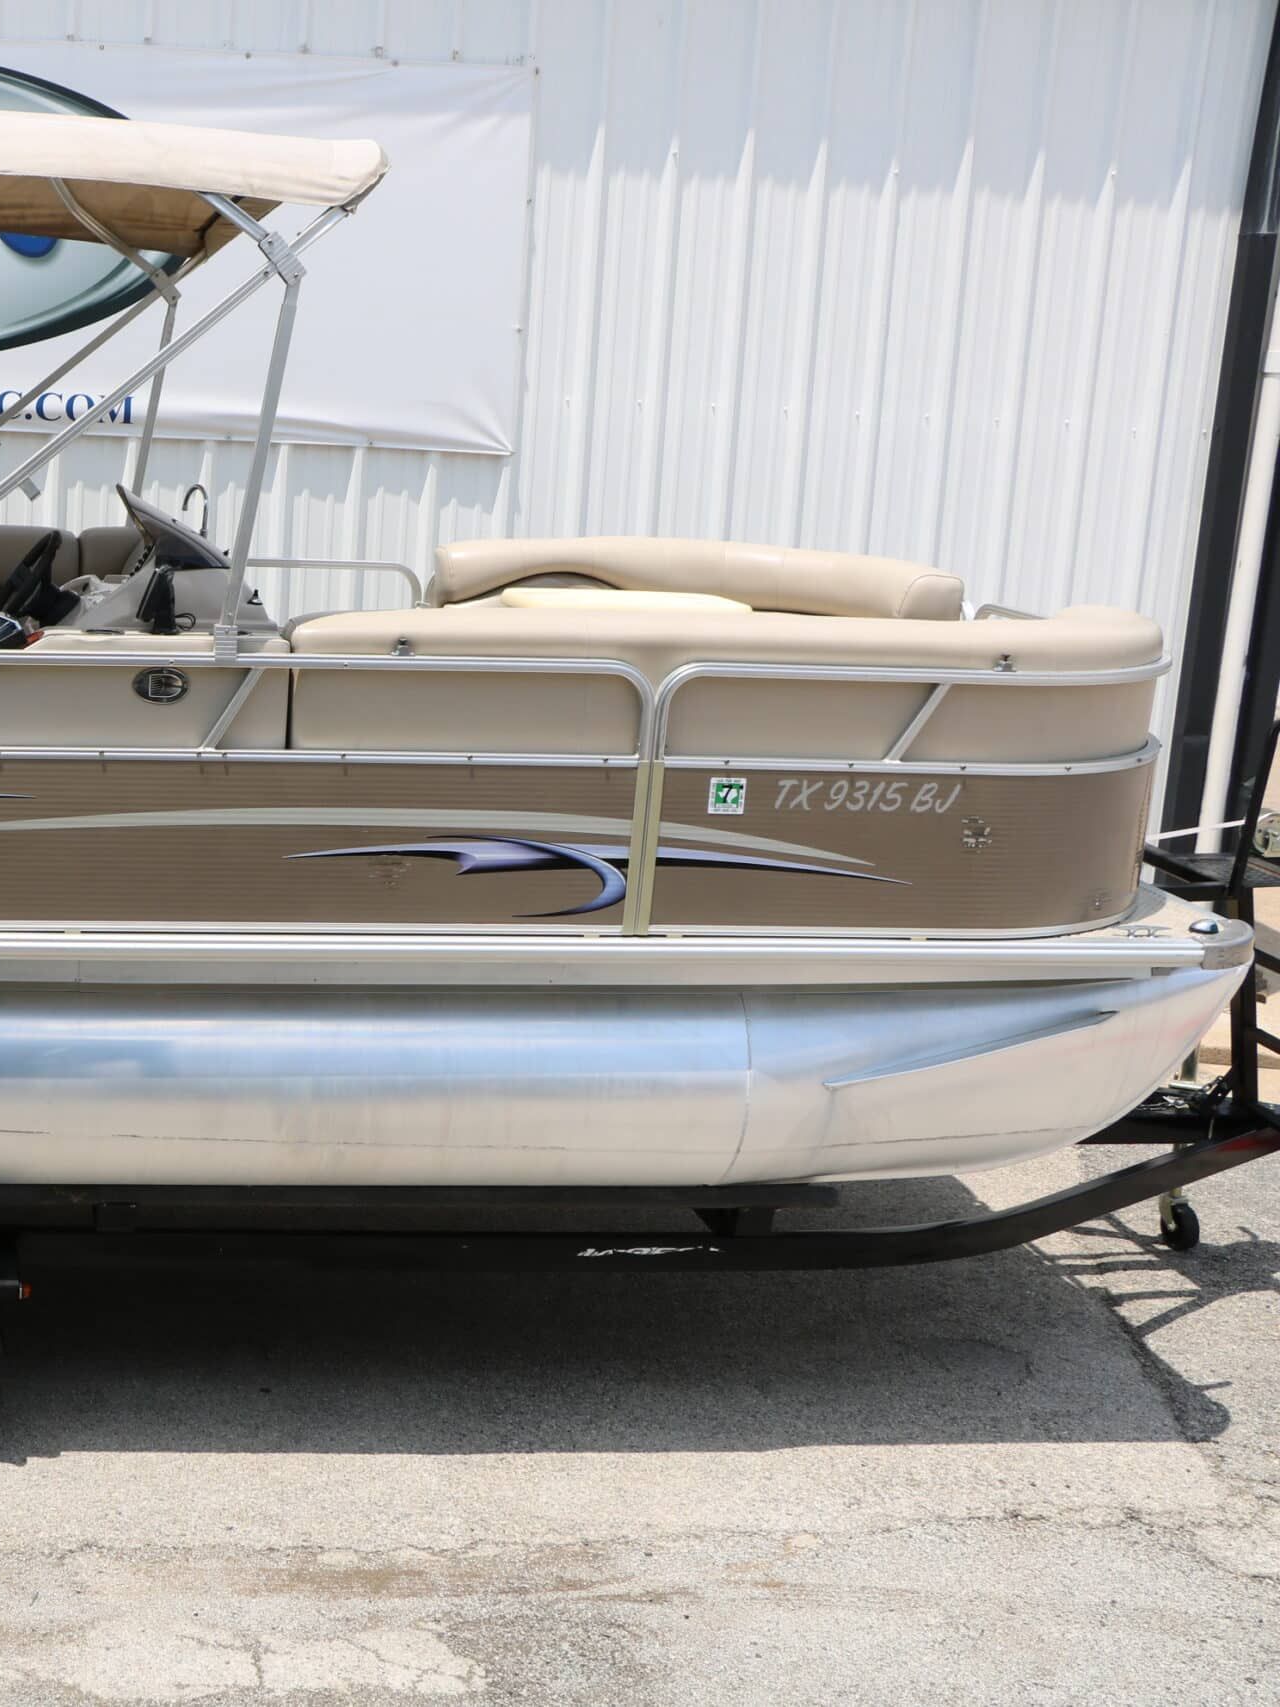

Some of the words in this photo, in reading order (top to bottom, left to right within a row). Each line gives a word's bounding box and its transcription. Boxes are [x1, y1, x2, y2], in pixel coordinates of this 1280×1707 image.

[774, 779, 823, 810] TX
[823, 780, 908, 811] 9315
[910, 782, 961, 813] BJ
